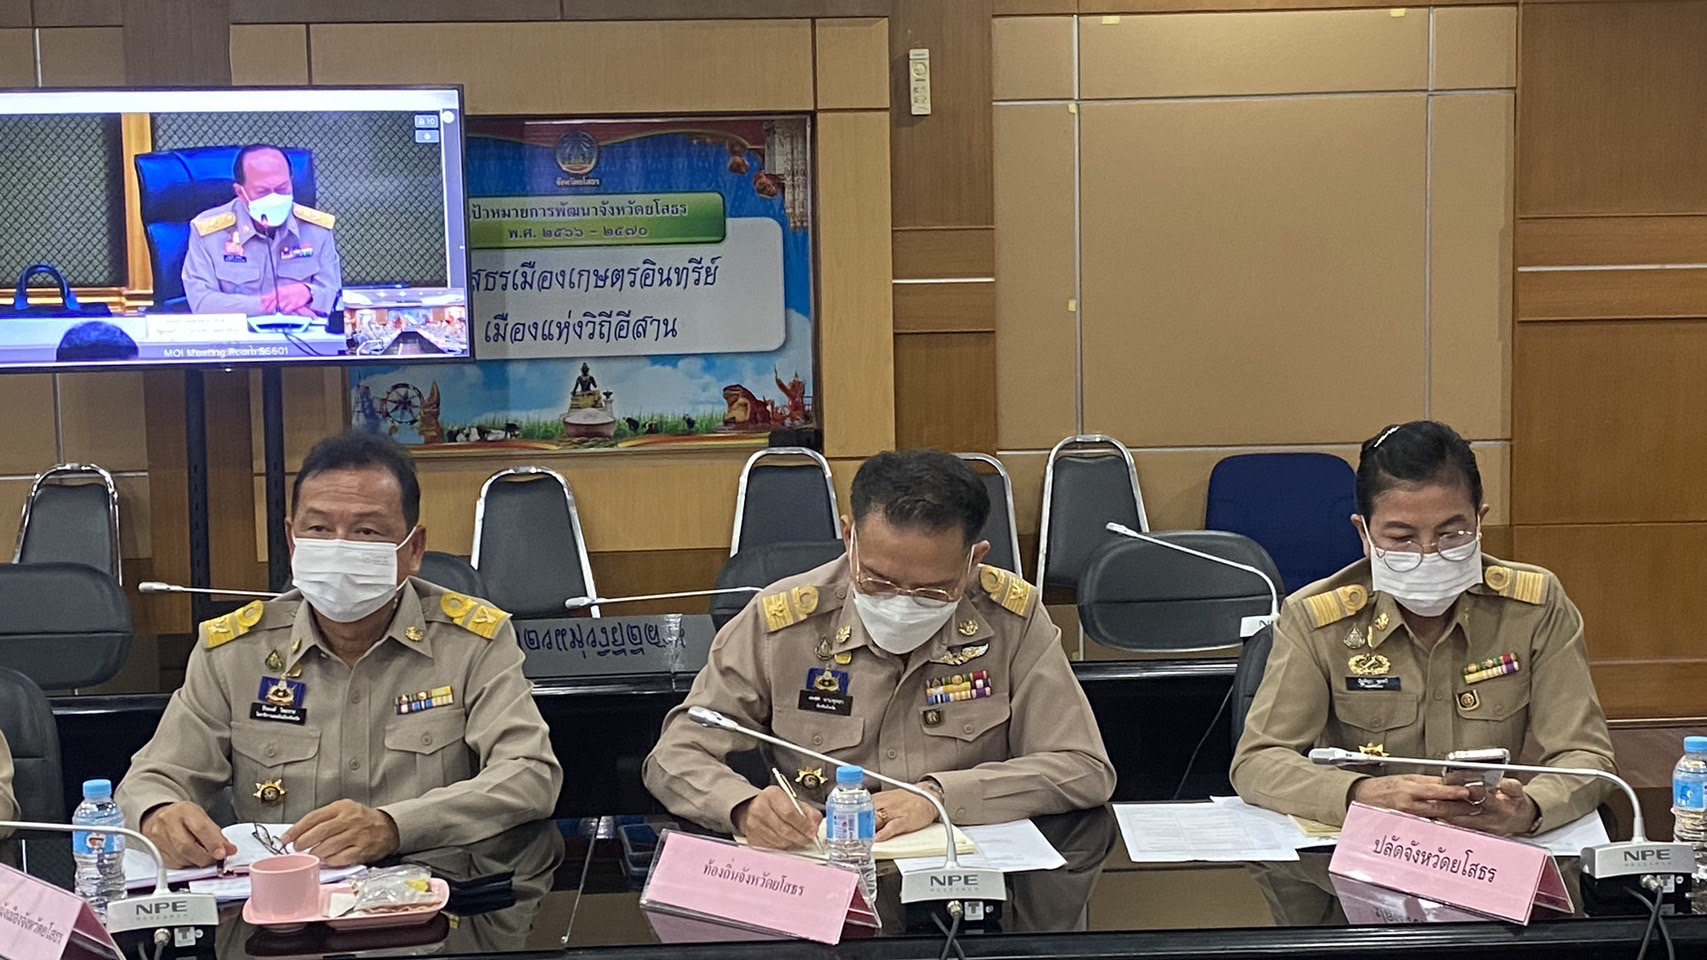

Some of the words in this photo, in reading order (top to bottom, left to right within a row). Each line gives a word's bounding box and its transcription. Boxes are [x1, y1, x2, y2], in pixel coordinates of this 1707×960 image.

[508, 227, 536, 239] พ.ศ.
[542, 226, 584, 238] ๒๕๖๖
[603, 225, 648, 237] ๒๕๗๐
[484, 310, 678, 344] เมืองแห่งวิถีอีสาน
[1373, 835, 1497, 882] ปลัดจังหวัดยโสธร
[1623, 849, 1671, 862] NPE
[703, 858, 805, 896] ท้องถิ่นจังหวัดยโสธร
[930, 874, 979, 887] NPE
[135, 900, 188, 915] NPE
